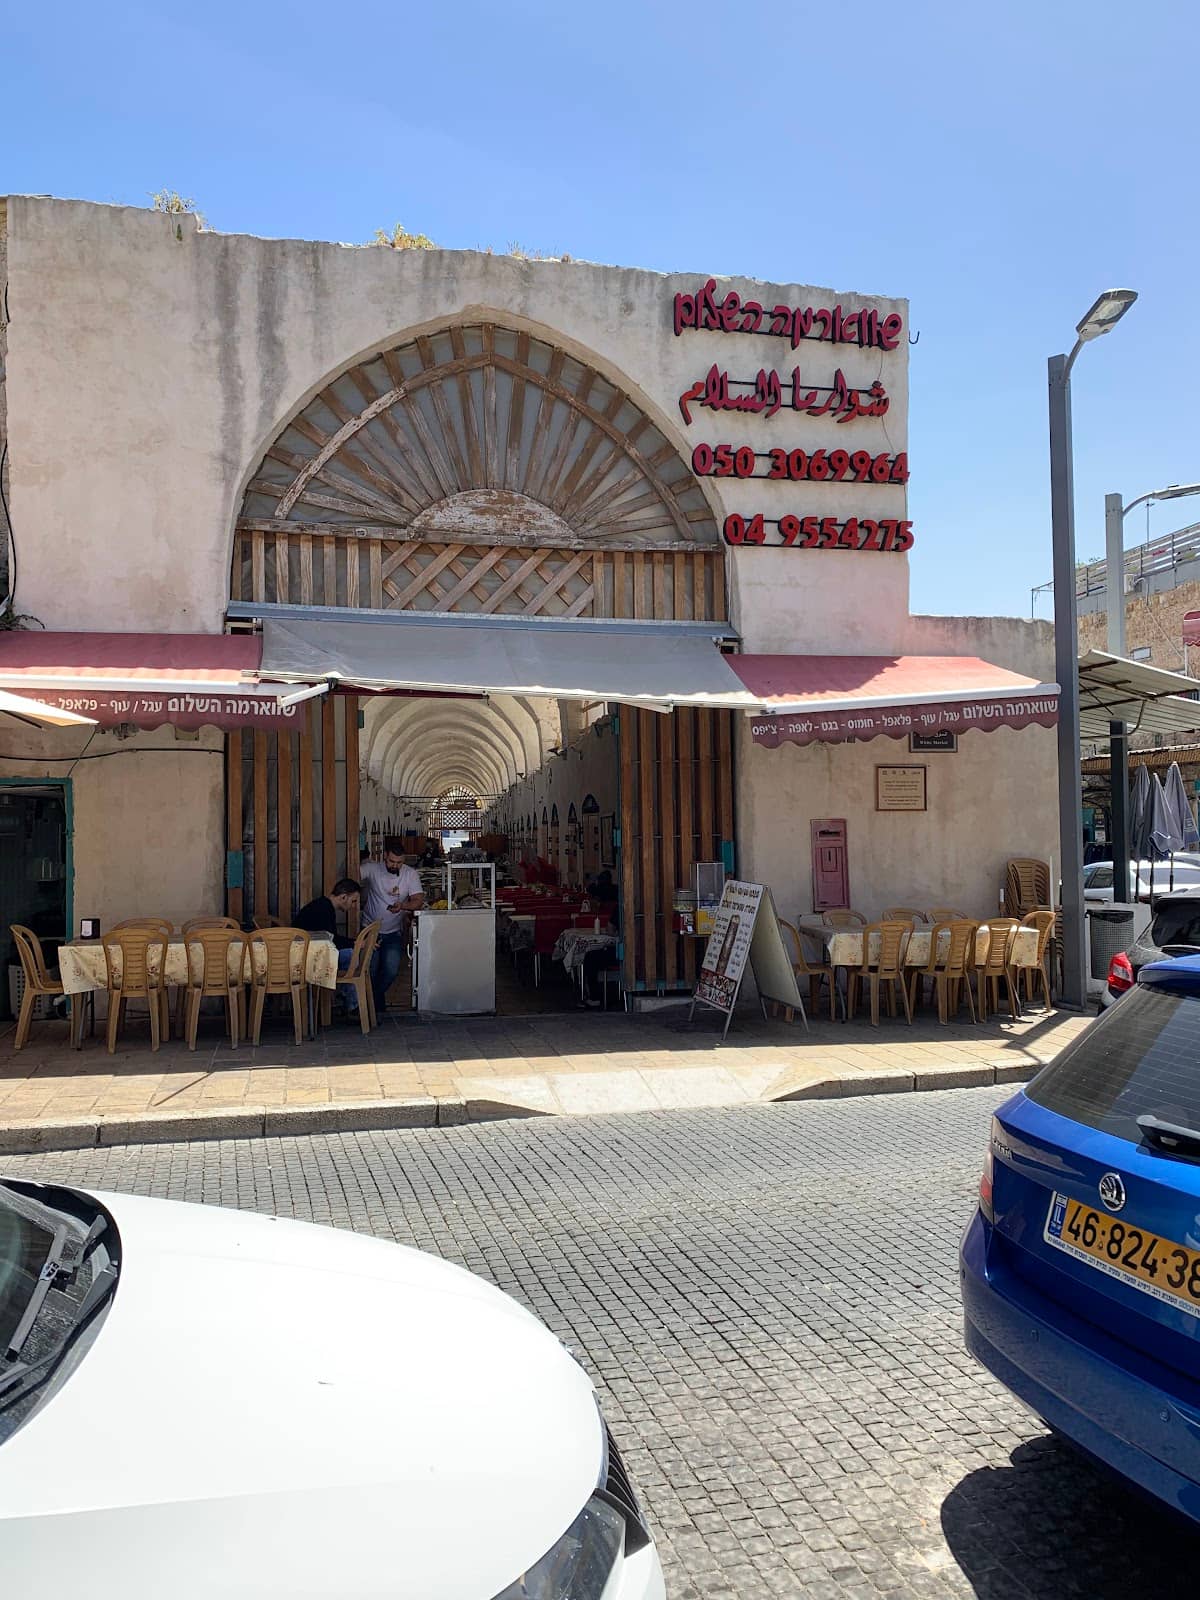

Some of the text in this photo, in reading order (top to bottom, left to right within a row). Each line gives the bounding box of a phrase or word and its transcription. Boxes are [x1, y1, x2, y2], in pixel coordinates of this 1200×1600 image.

[673, 279, 763, 336] השלום
[679, 363, 890, 426] شوارما السلام
[692, 443, 910, 484] 050 3069964
[724, 513, 914, 551] 04 9554275
[58, 697, 97, 710] פלאפל
[110, 700, 130, 714] עוף
[141, 700, 163, 713] עגל
[167, 694, 222, 713] השלום
[1006, 700, 1058, 716] שווארמה
[944, 711, 960, 722] עגל
[963, 704, 1004, 719] השלום
[821, 721, 839, 731] בגט
[847, 718, 874, 729] חומוס
[882, 714, 911, 726] פלאפל
[921, 713, 936, 726] עוף
[789, 720, 813, 733] לאפה
